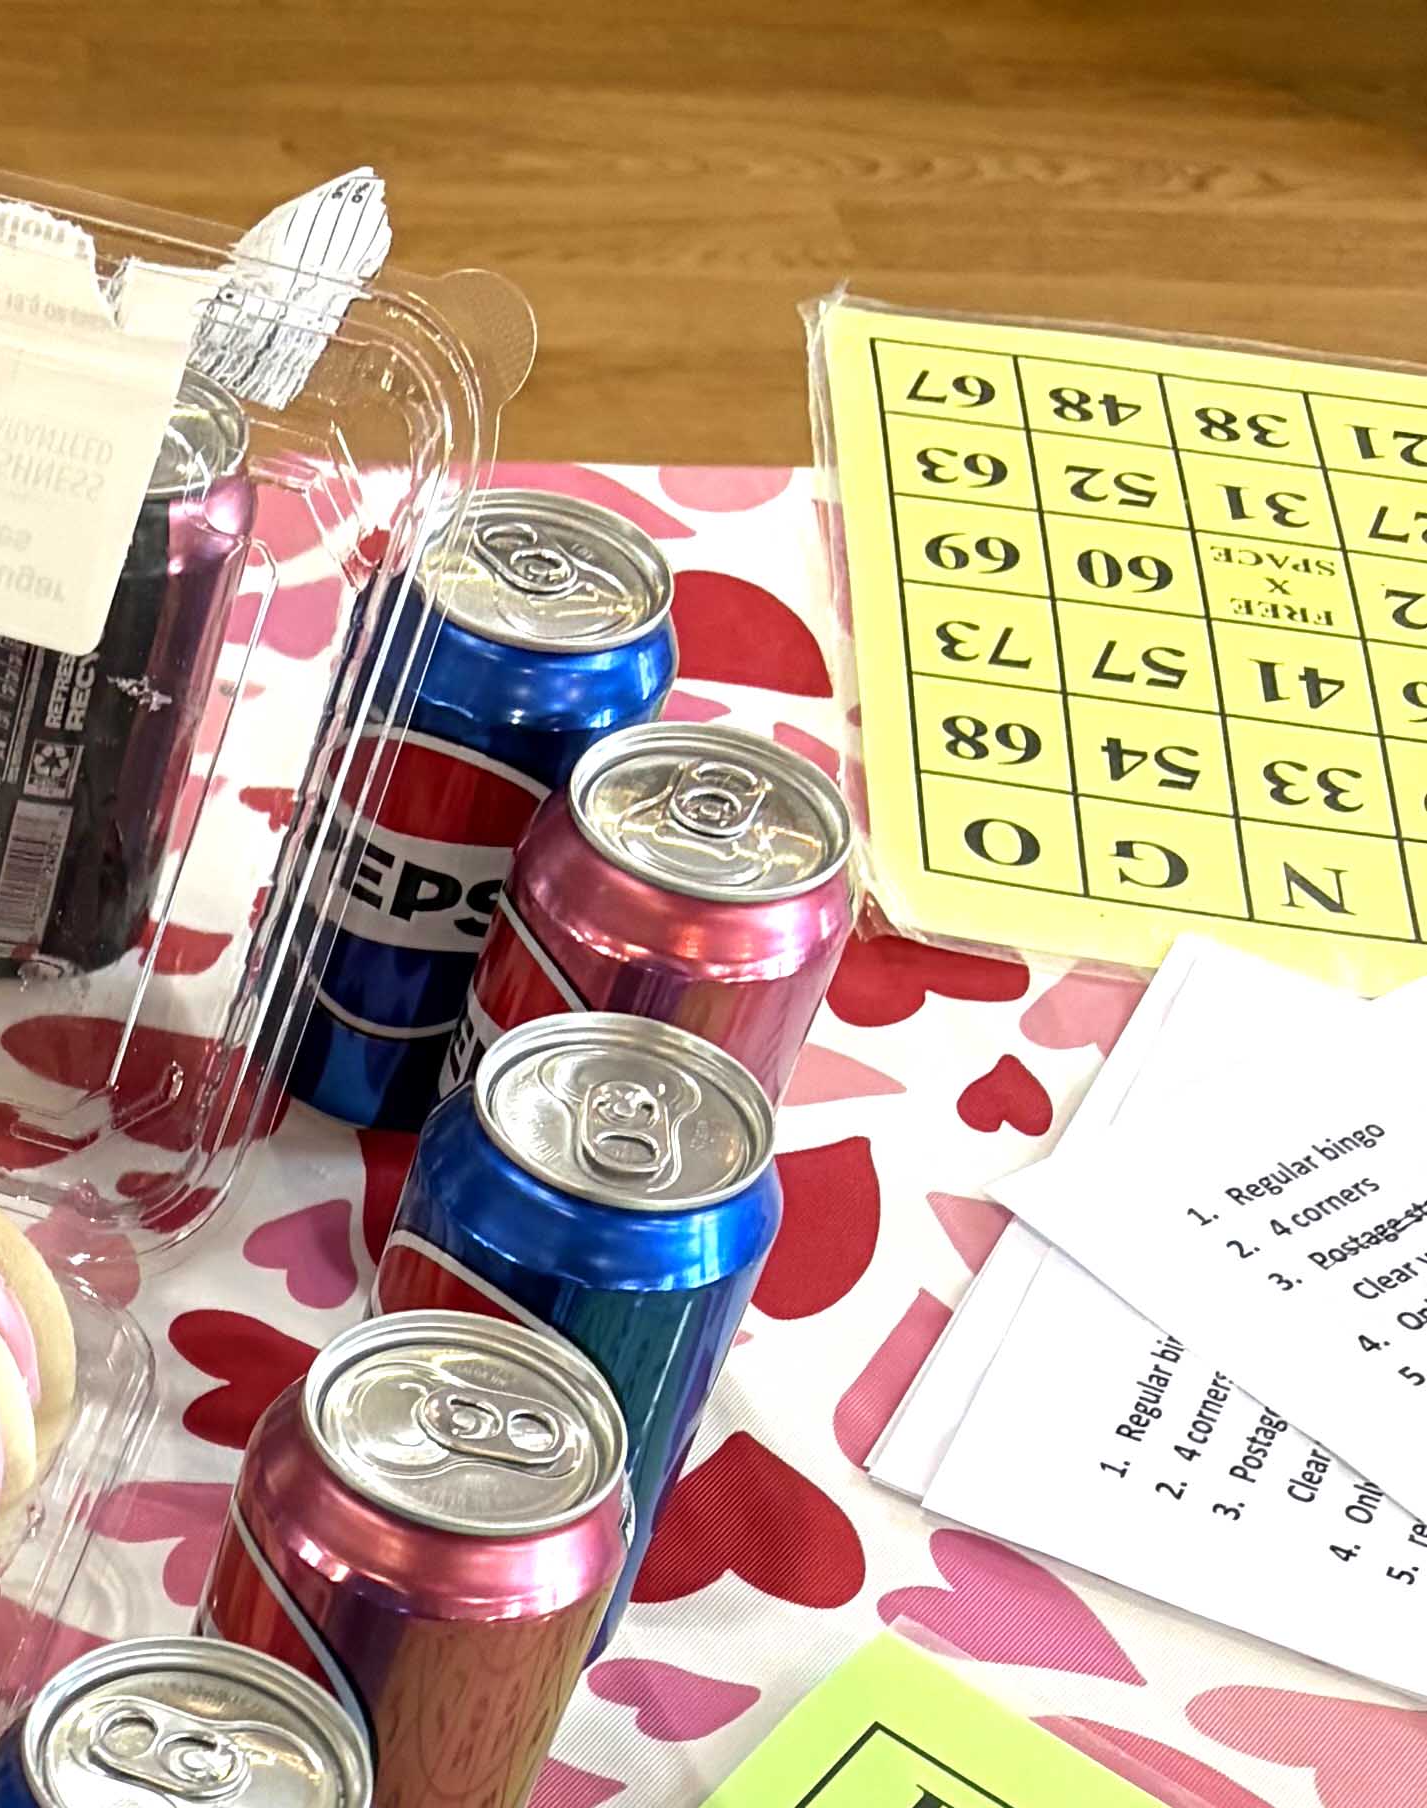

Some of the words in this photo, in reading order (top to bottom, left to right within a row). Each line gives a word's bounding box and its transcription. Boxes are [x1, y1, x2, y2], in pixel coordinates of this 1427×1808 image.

[907, 370, 996, 407] 67
[1048, 387, 1142, 427] 48
[1194, 407, 1289, 448] 38
[916, 447, 1008, 488] 63
[1064, 465, 1157, 508] 52
[1221, 483, 1310, 528] 31
[1368, 505, 1427, 543] 7
[924, 533, 1020, 574] 69
[1077, 548, 1174, 593] 60
[1211, 545, 1335, 578] SPACE
[1266, 577, 1291, 596] X
[1231, 597, 1334, 628] FREE
[45, 652, 77, 730] REFRES
[64, 652, 101, 732] RECY
[934, 620, 1033, 670] 73
[1091, 639, 1188, 690] 57
[1250, 657, 1345, 709] 41
[941, 714, 1042, 766] 68
[1100, 736, 1201, 791] 54
[1262, 759, 1364, 814] 33
[963, 817, 1042, 867] O
[1108, 839, 1189, 889] G
[1280, 861, 1357, 916] N
[1187, 1207, 1221, 1227] 1.
[1225, 1155, 1319, 1206] Regular
[1311, 1124, 1385, 1161] bingo
[1226, 1239, 1261, 1259] 2.
[1270, 1218, 1292, 1236] 4
[1291, 1178, 1380, 1229] corners
[1268, 1272, 1303, 1291] 3.
[1307, 1216, 1400, 1270] Postage
[1352, 1261, 1420, 1300] Clear
[1357, 1333, 1390, 1353] 4.
[1115, 1364, 1174, 1443] Regular
[1100, 1459, 1131, 1479] 1.
[1155, 1480, 1189, 1500] 2.
[1173, 1445, 1202, 1462] 4
[1287, 1447, 1332, 1504] Clear
[1212, 1501, 1246, 1521] 3.
[1329, 1543, 1362, 1562] 4.
[1386, 1565, 1420, 1585] 5.
